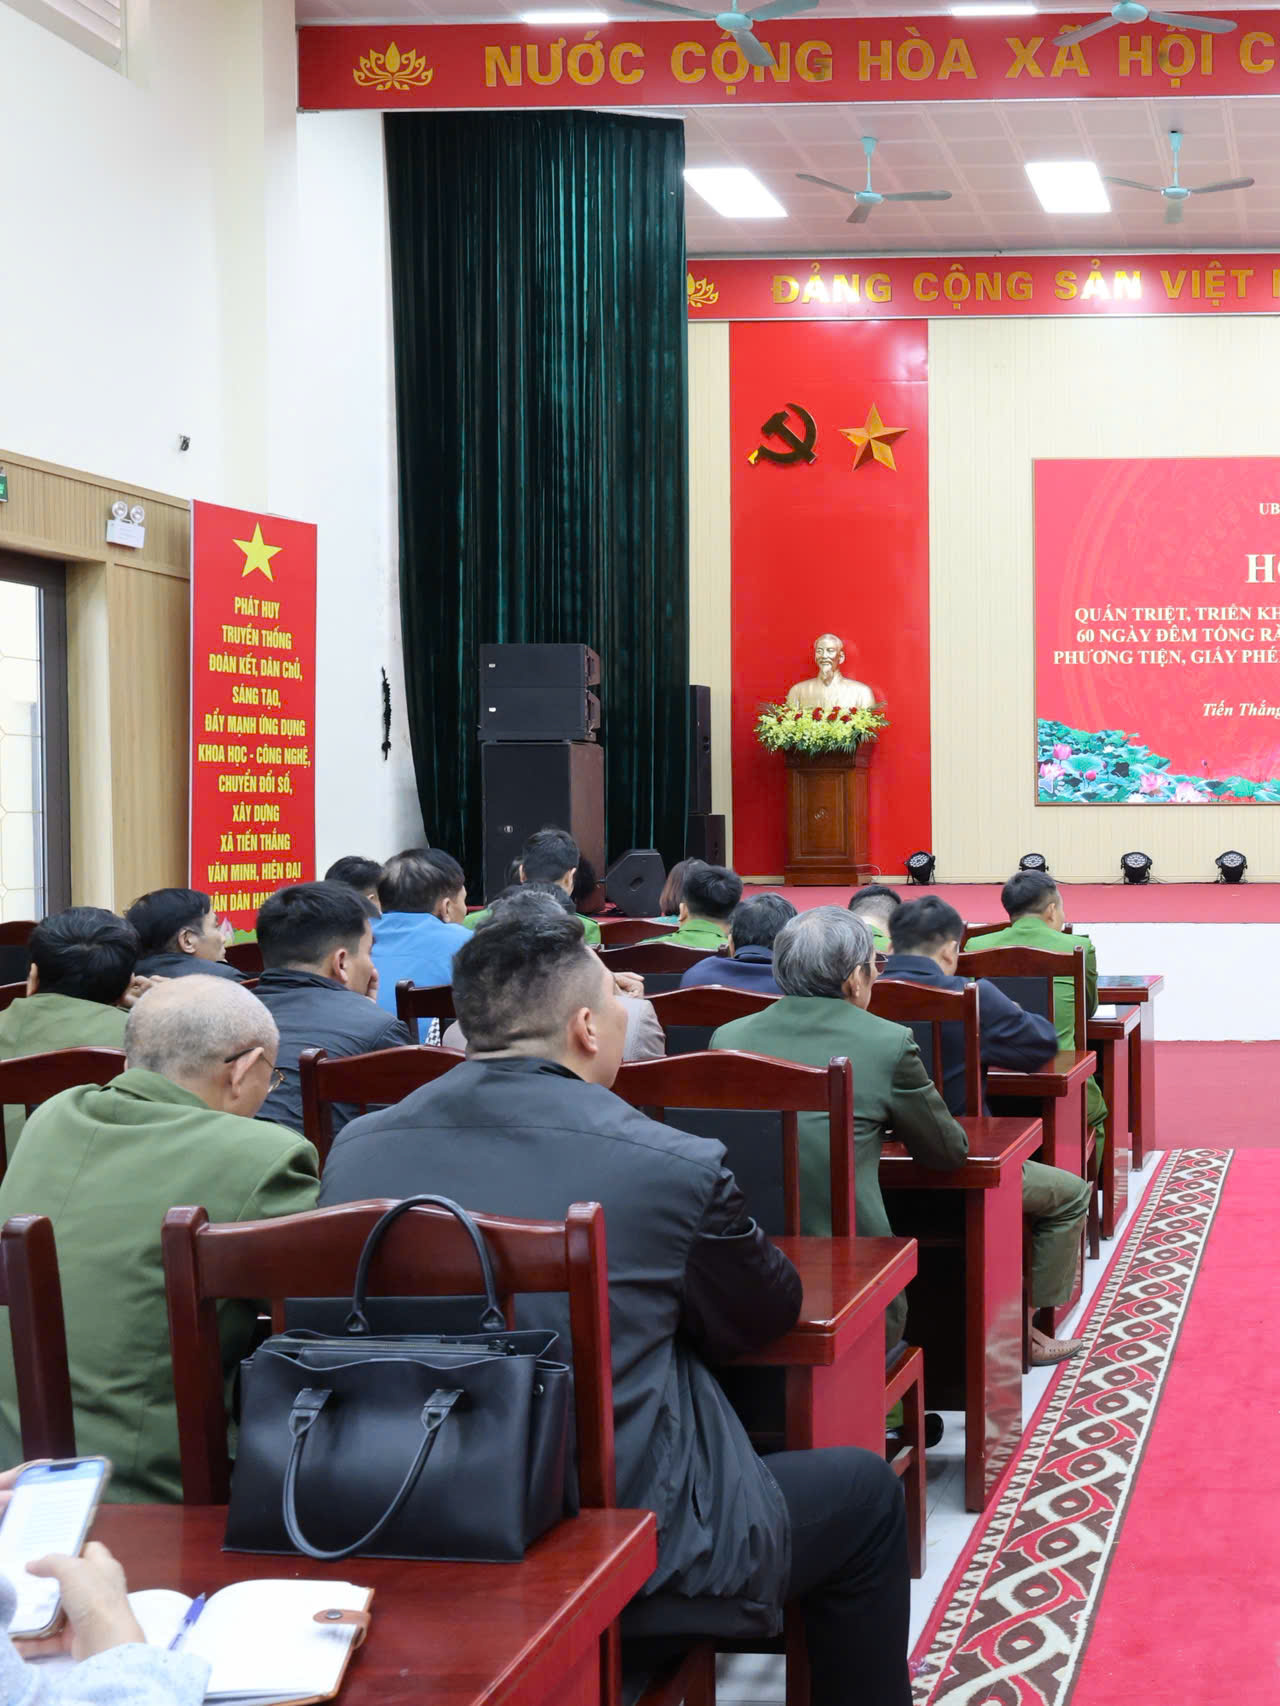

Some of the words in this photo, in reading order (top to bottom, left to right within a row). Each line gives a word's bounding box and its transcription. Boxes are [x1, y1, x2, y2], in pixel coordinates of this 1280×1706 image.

[485, 32, 644, 87] NƯỚC
[672, 32, 832, 94] CỘNG
[859, 26, 976, 80] HÒA
[1008, 25, 1088, 77] XÃ
[1120, 26, 1213, 86] HỘI
[771, 262, 892, 305] ĐẢNG
[913, 263, 1034, 310] CỘNG
[1054, 258, 1142, 300] SẢN
[1160, 261, 1254, 306] VIỆT
[235, 596, 259, 616] PHÁT
[262, 601, 280, 619] HUY
[1075, 604, 1127, 624] QUÁN
[1131, 606, 1191, 624] TRIỆT,
[261, 626, 291, 649] THỐNG
[1077, 629, 1094, 642] 60
[1100, 625, 1151, 642] NGÀY
[1157, 624, 1197, 642] ĐÊM
[209, 652, 238, 673] ĐOÀN
[239, 653, 258, 677] KẾT,
[261, 657, 280, 677] DÂN
[1054, 649, 1133, 664] PHƯƠNG
[1138, 648, 1186, 667] TIỆN,
[232, 683, 260, 704] SÁNG
[261, 689, 281, 709] TẠO,
[1204, 700, 1233, 716] Tiến
[205, 708, 224, 732] ĐẨY
[228, 716, 256, 736] MẠNH
[259, 714, 278, 735] ỨNG
[281, 719, 305, 739] DỤNG
[199, 744, 225, 762] KHOA
[228, 746, 248, 768] HỌC
[256, 744, 282, 764] CÔNG
[284, 746, 310, 768] NGHỆ,
[219, 769, 257, 792] CHUYỂN
[259, 770, 275, 792] ĐỔI
[278, 771, 292, 794] SỐ,
[233, 802, 253, 821] XÂY
[254, 804, 279, 825] DỰNG
[221, 832, 233, 852] XÃ
[236, 829, 258, 851] TIẾN
[260, 828, 290, 850] THẮNG
[208, 862, 228, 882] VĂN
[231, 864, 259, 881] MINH,
[262, 860, 283, 883] HIỆN
[286, 862, 301, 881] ĐẠI
[230, 890, 250, 911] DÂN
